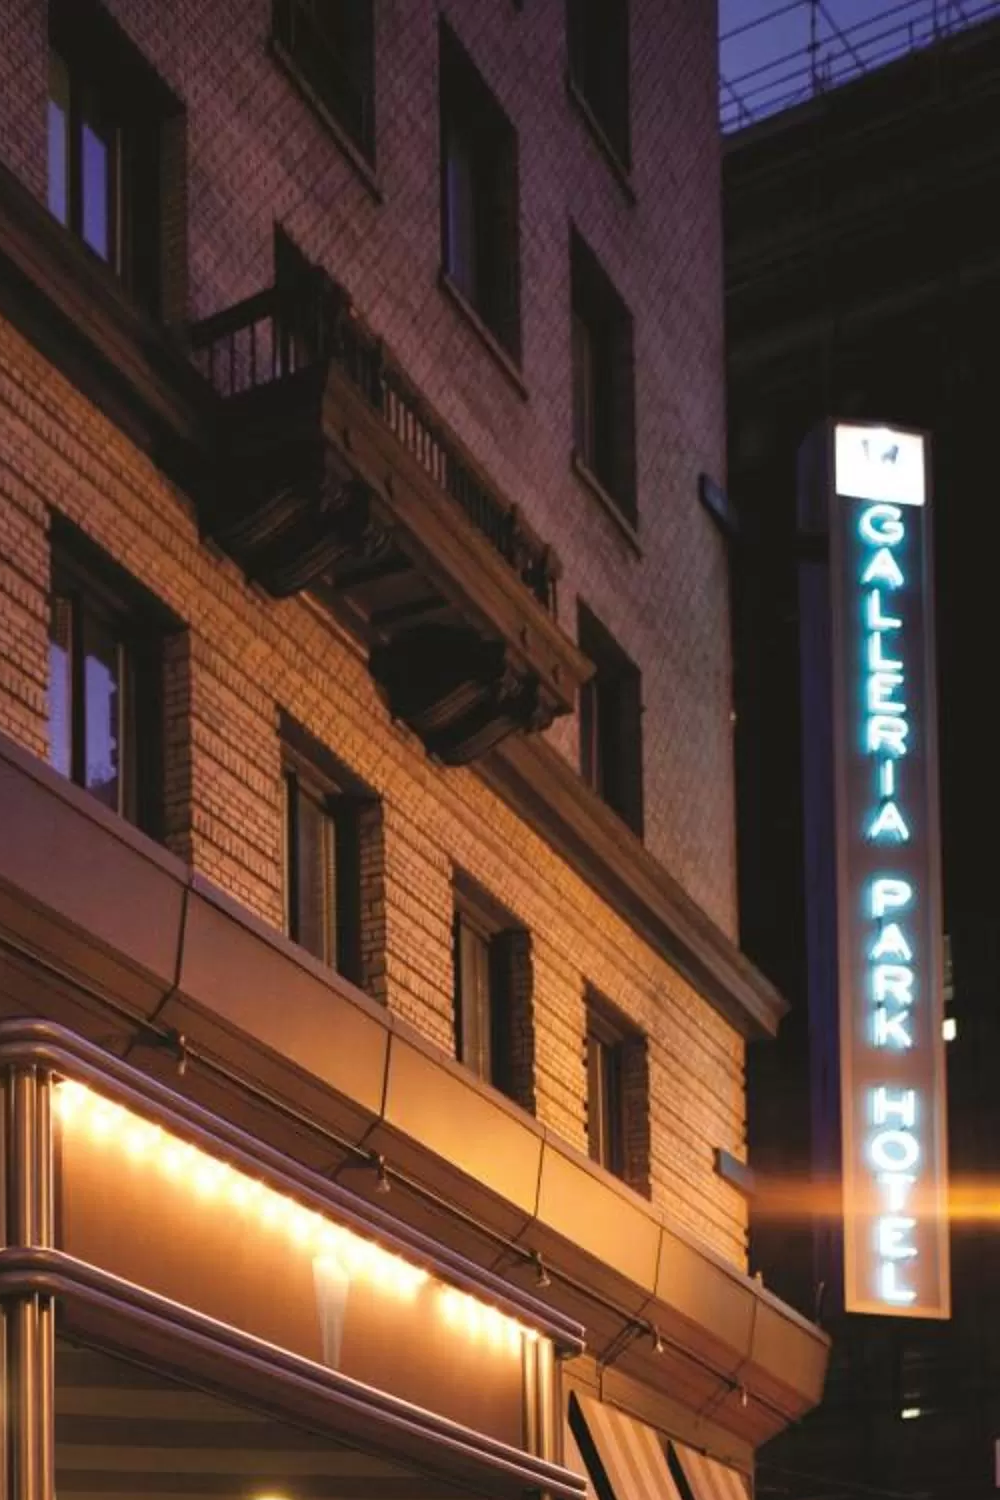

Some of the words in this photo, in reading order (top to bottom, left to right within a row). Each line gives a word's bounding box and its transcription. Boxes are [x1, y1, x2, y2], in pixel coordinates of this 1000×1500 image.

[859, 504, 910, 842] GALLERIA
[868, 878, 914, 1048] PARK
[869, 1086, 920, 1306] HOTEL
